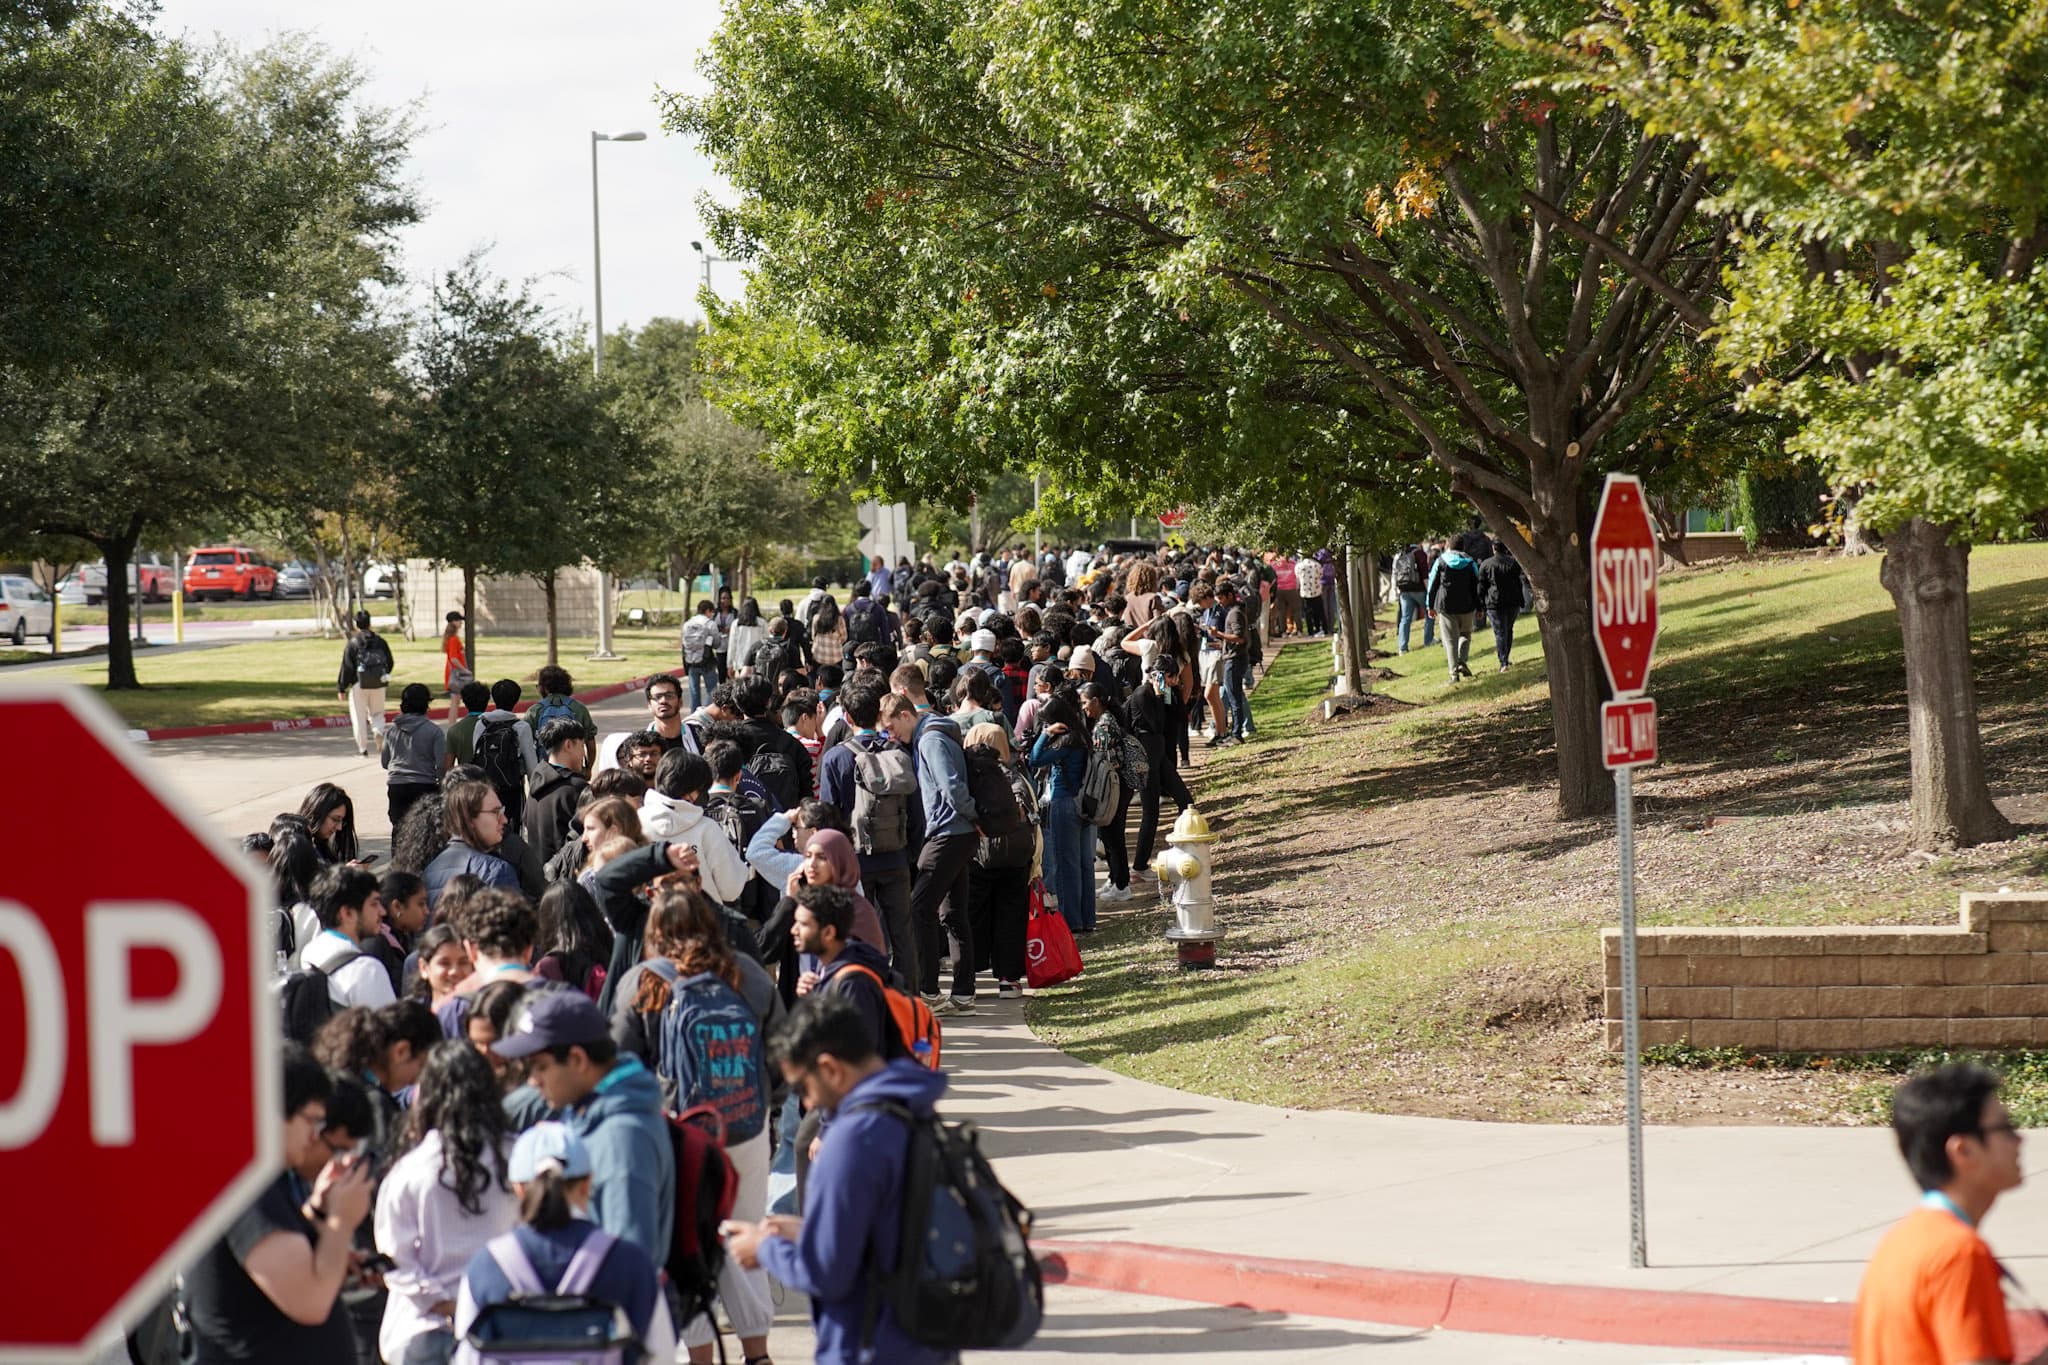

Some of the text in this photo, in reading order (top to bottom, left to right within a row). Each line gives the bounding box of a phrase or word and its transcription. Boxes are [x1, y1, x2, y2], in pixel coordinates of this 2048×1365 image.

[1598, 547, 1656, 628] STOP
[1605, 711, 1653, 755] ALL WAY
